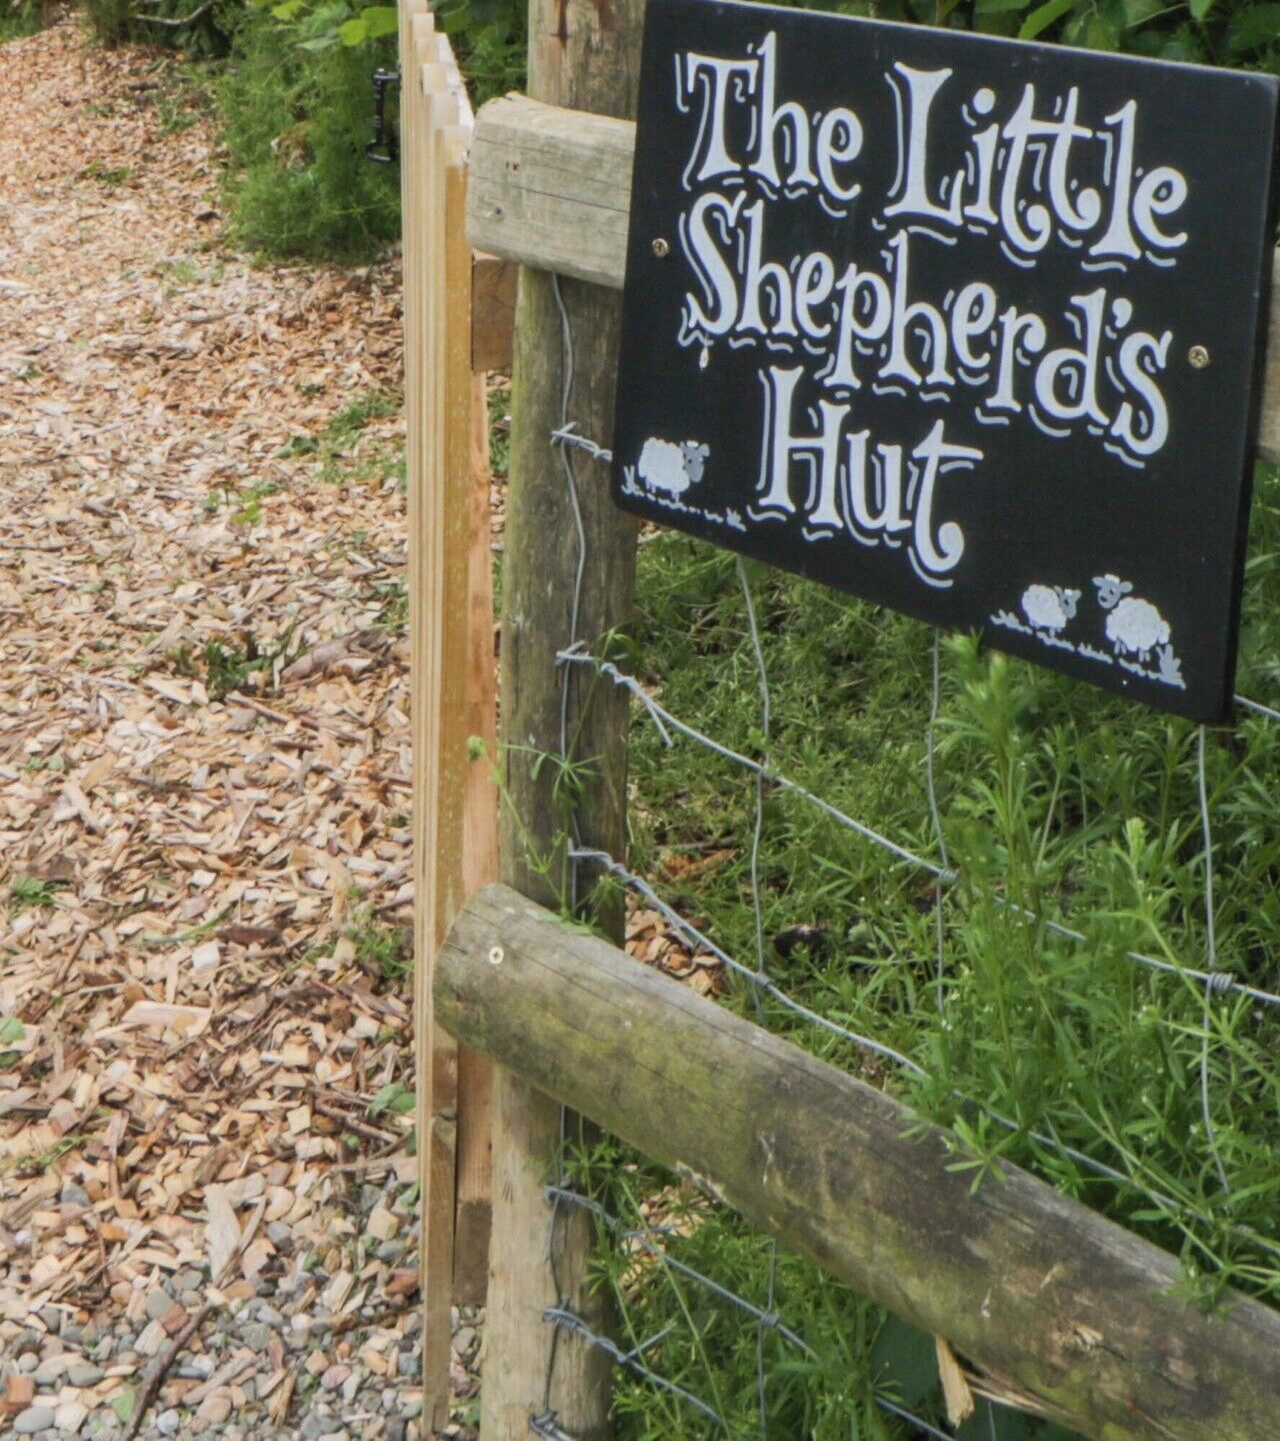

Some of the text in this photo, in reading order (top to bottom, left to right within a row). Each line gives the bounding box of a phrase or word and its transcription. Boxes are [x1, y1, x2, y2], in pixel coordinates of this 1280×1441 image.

[685, 31, 1188, 260] The Little
[685, 191, 1173, 457] Shepherd's
[758, 364, 984, 573] Hut
